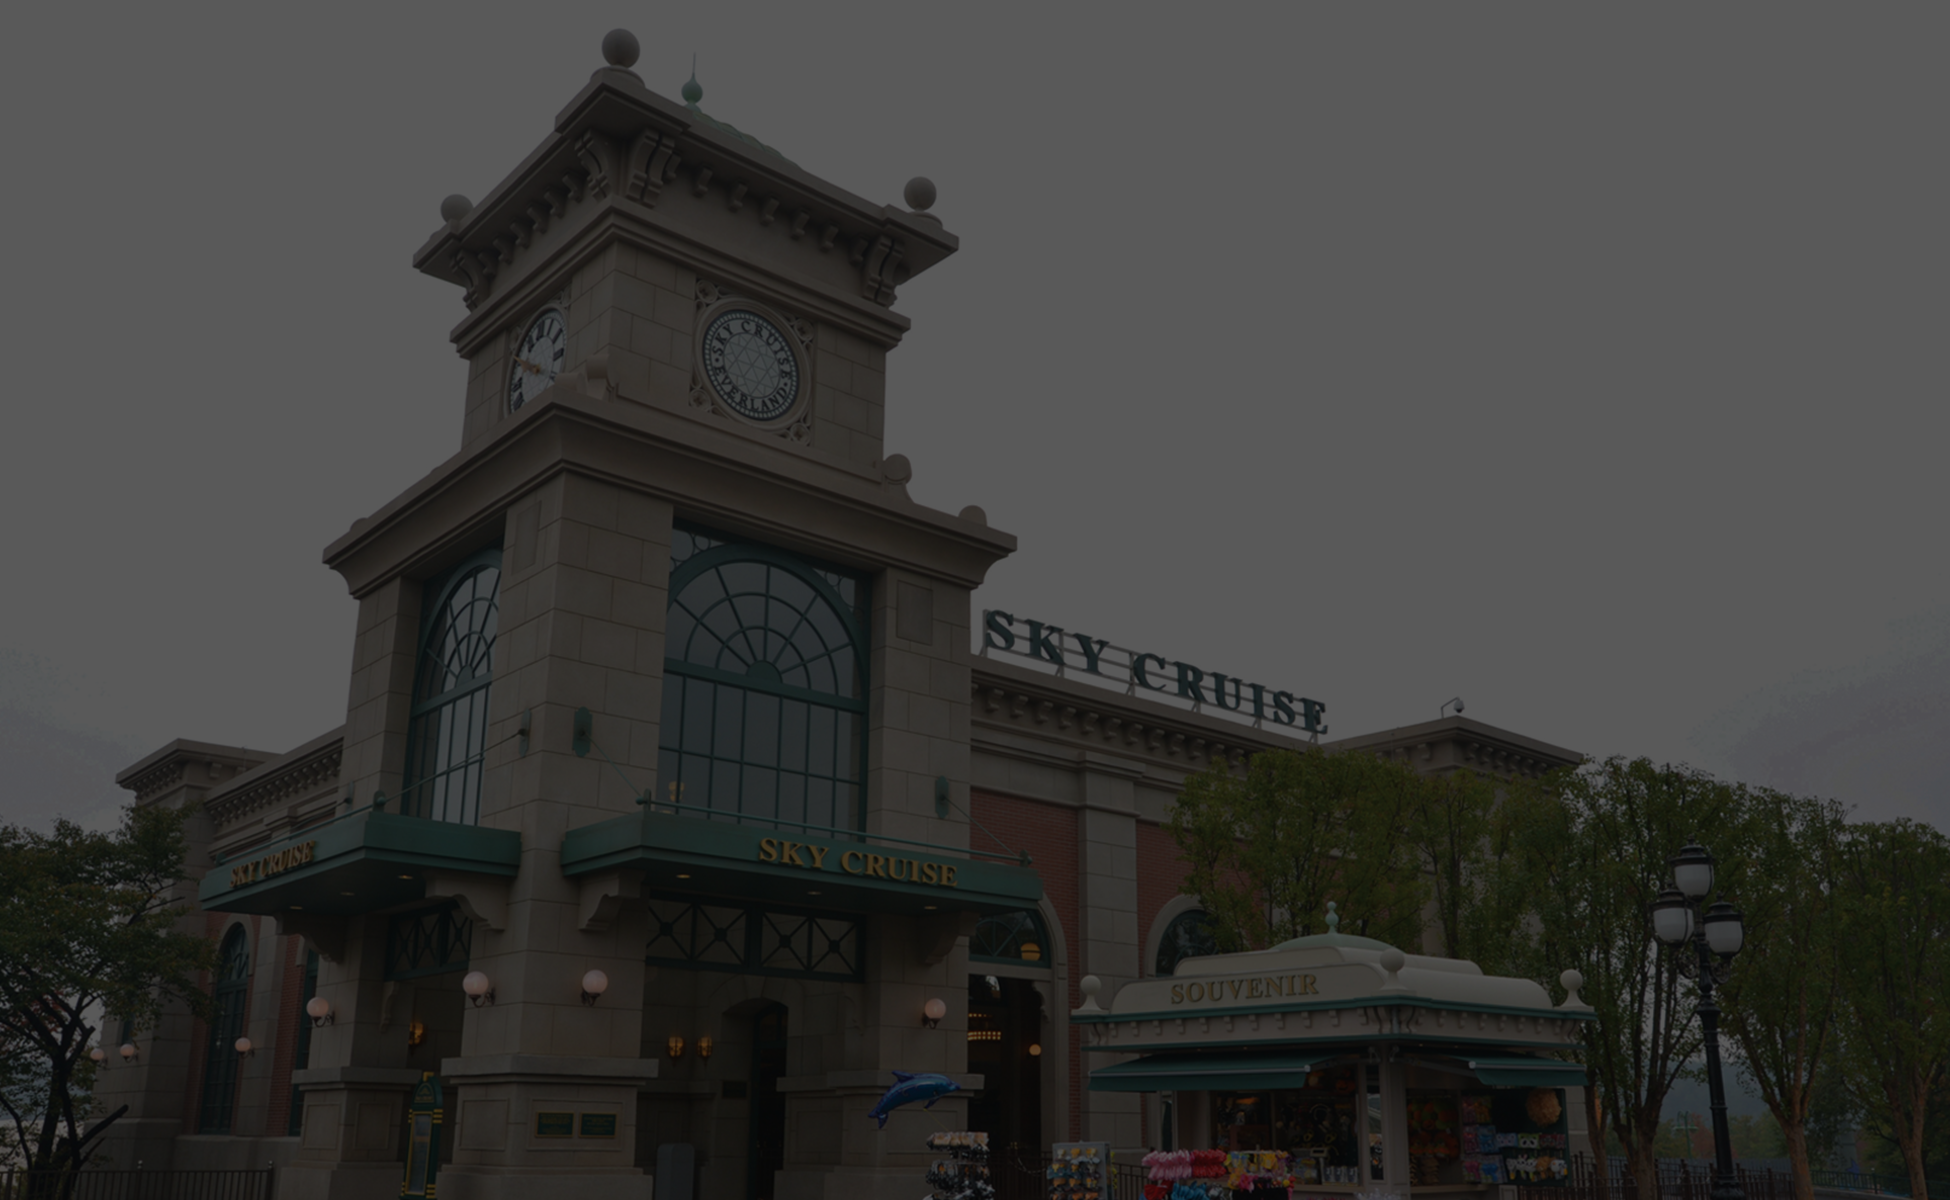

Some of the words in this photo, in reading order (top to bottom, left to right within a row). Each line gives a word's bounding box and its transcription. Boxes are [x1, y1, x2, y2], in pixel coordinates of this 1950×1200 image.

[711, 323, 734, 356] SKY
[741, 320, 792, 380] CRUISE
[714, 366, 788, 411] EVERLAND
[985, 609, 1110, 675] SKY
[1133, 652, 1328, 735] CRUISE
[230, 860, 260, 888] SKY
[260, 840, 315, 878] CRUISE
[759, 837, 830, 869] SKY
[840, 850, 958, 887] CRUISE
[1171, 974, 1319, 1004] SOUVENIR
